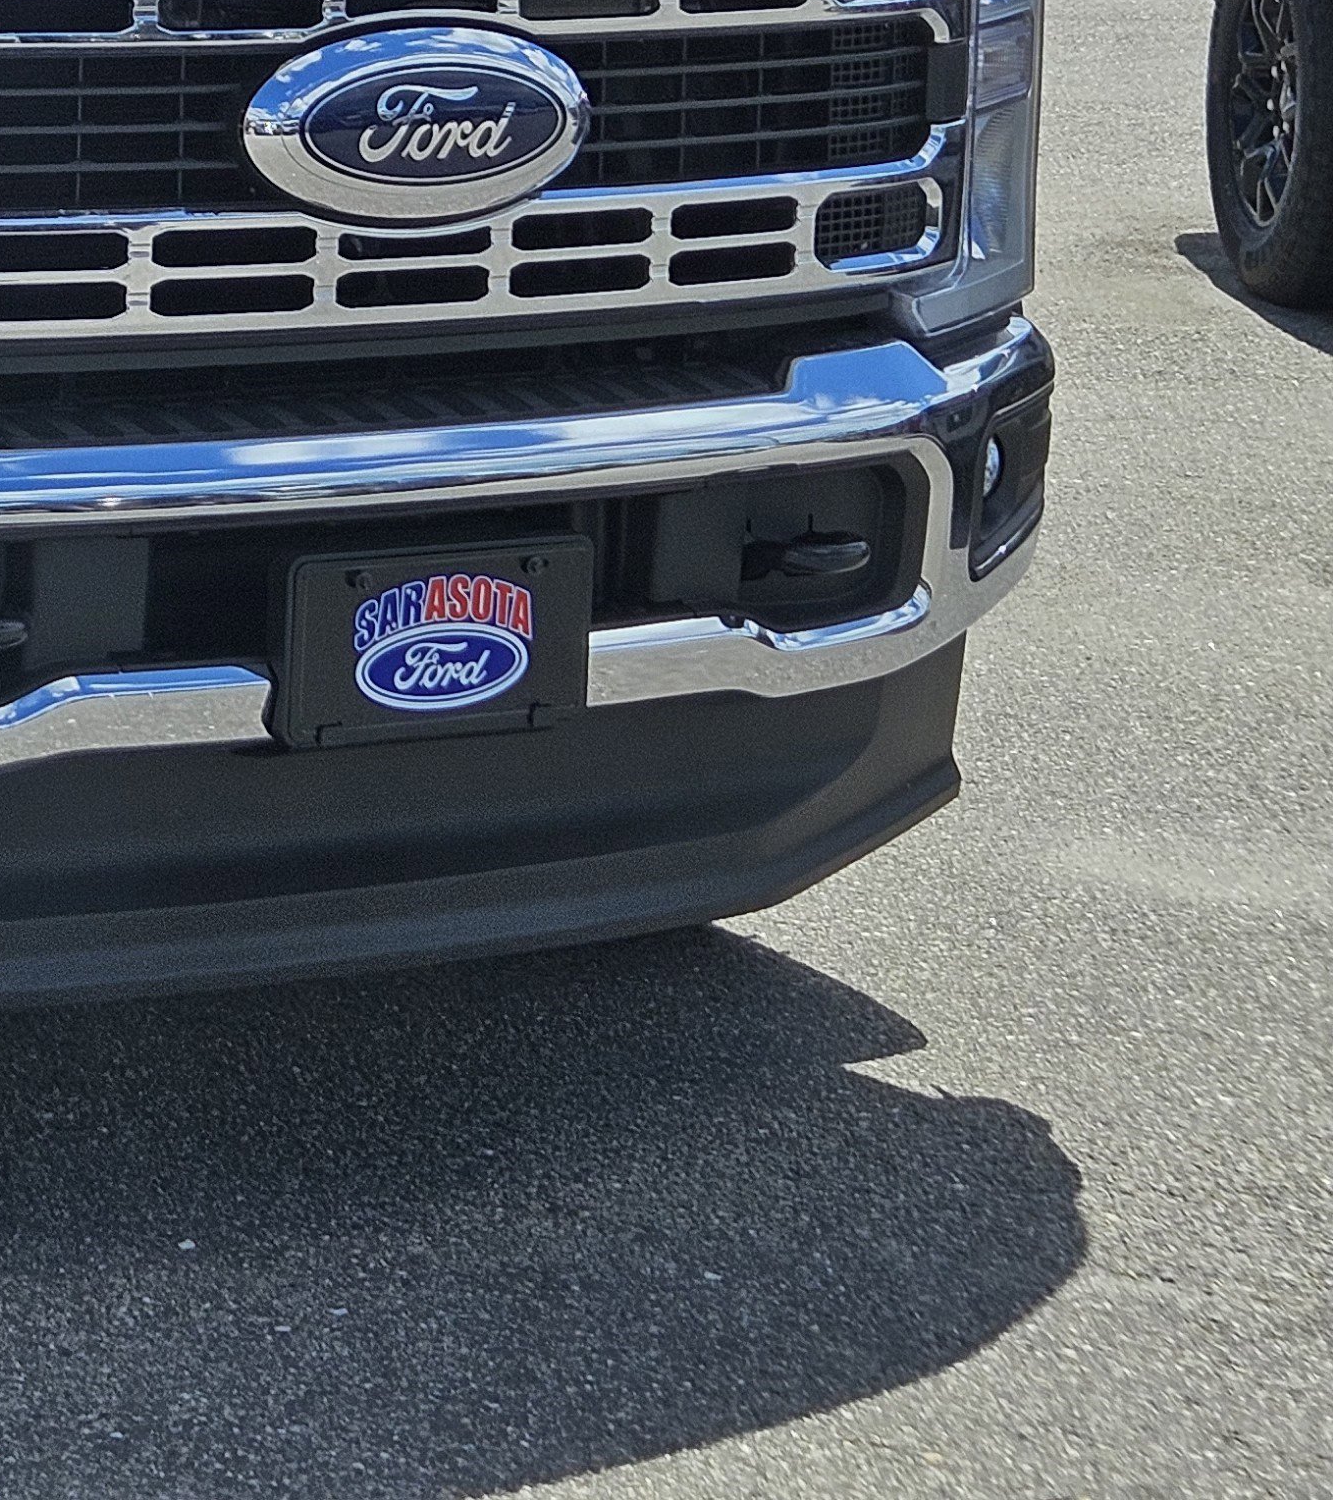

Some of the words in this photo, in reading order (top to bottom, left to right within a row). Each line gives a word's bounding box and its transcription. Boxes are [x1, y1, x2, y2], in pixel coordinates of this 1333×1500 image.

[358, 84, 516, 163] Ford
[353, 573, 533, 652] SARASOTA
[393, 641, 491, 691] Ford
